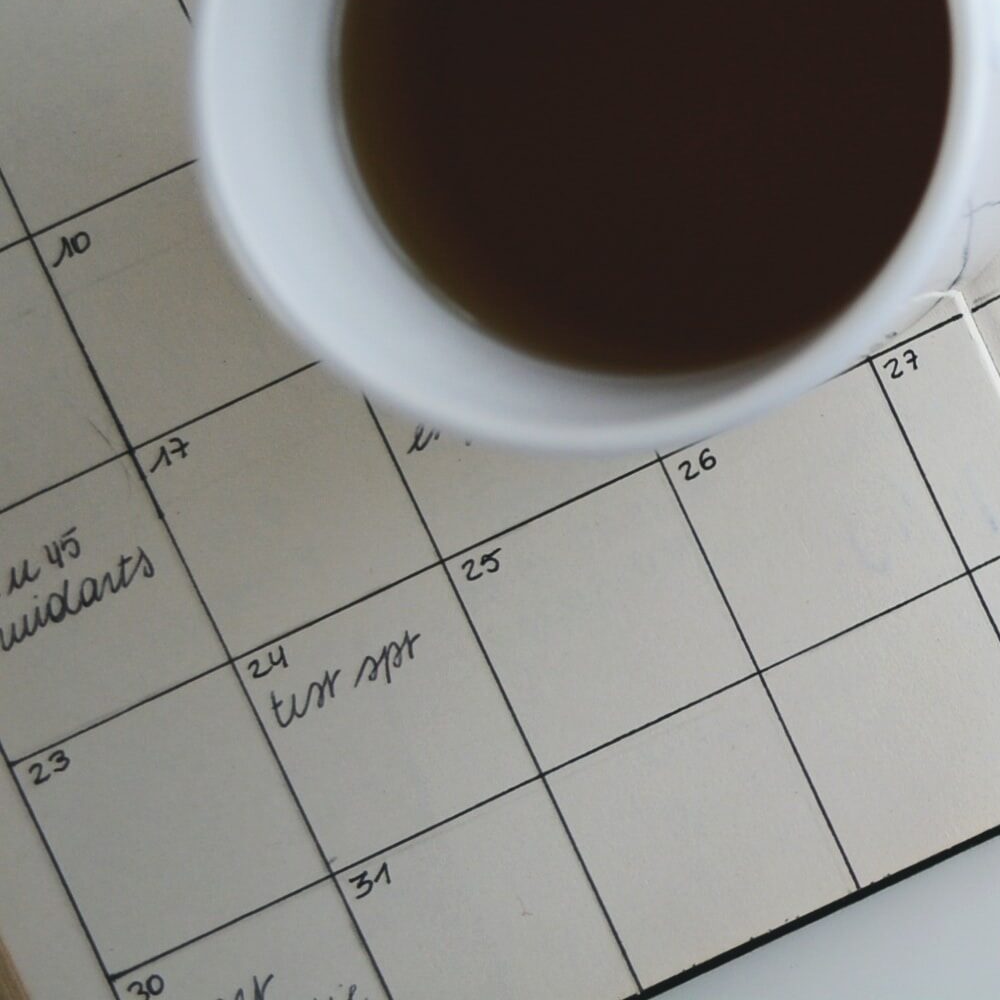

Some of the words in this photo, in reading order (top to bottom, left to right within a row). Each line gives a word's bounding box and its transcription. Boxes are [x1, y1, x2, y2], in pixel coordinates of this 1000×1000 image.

[52, 231, 91, 269] 10
[882, 348, 921, 381] 27
[149, 437, 190, 473] 17
[678, 447, 718, 484] 26
[43, 526, 81, 569] 45
[461, 548, 502, 582] 25
[0, 546, 155, 651] uidarts
[247, 645, 289, 680] 24
[271, 669, 342, 728] test
[28, 749, 72, 786] 23
[349, 862, 391, 899] 31
